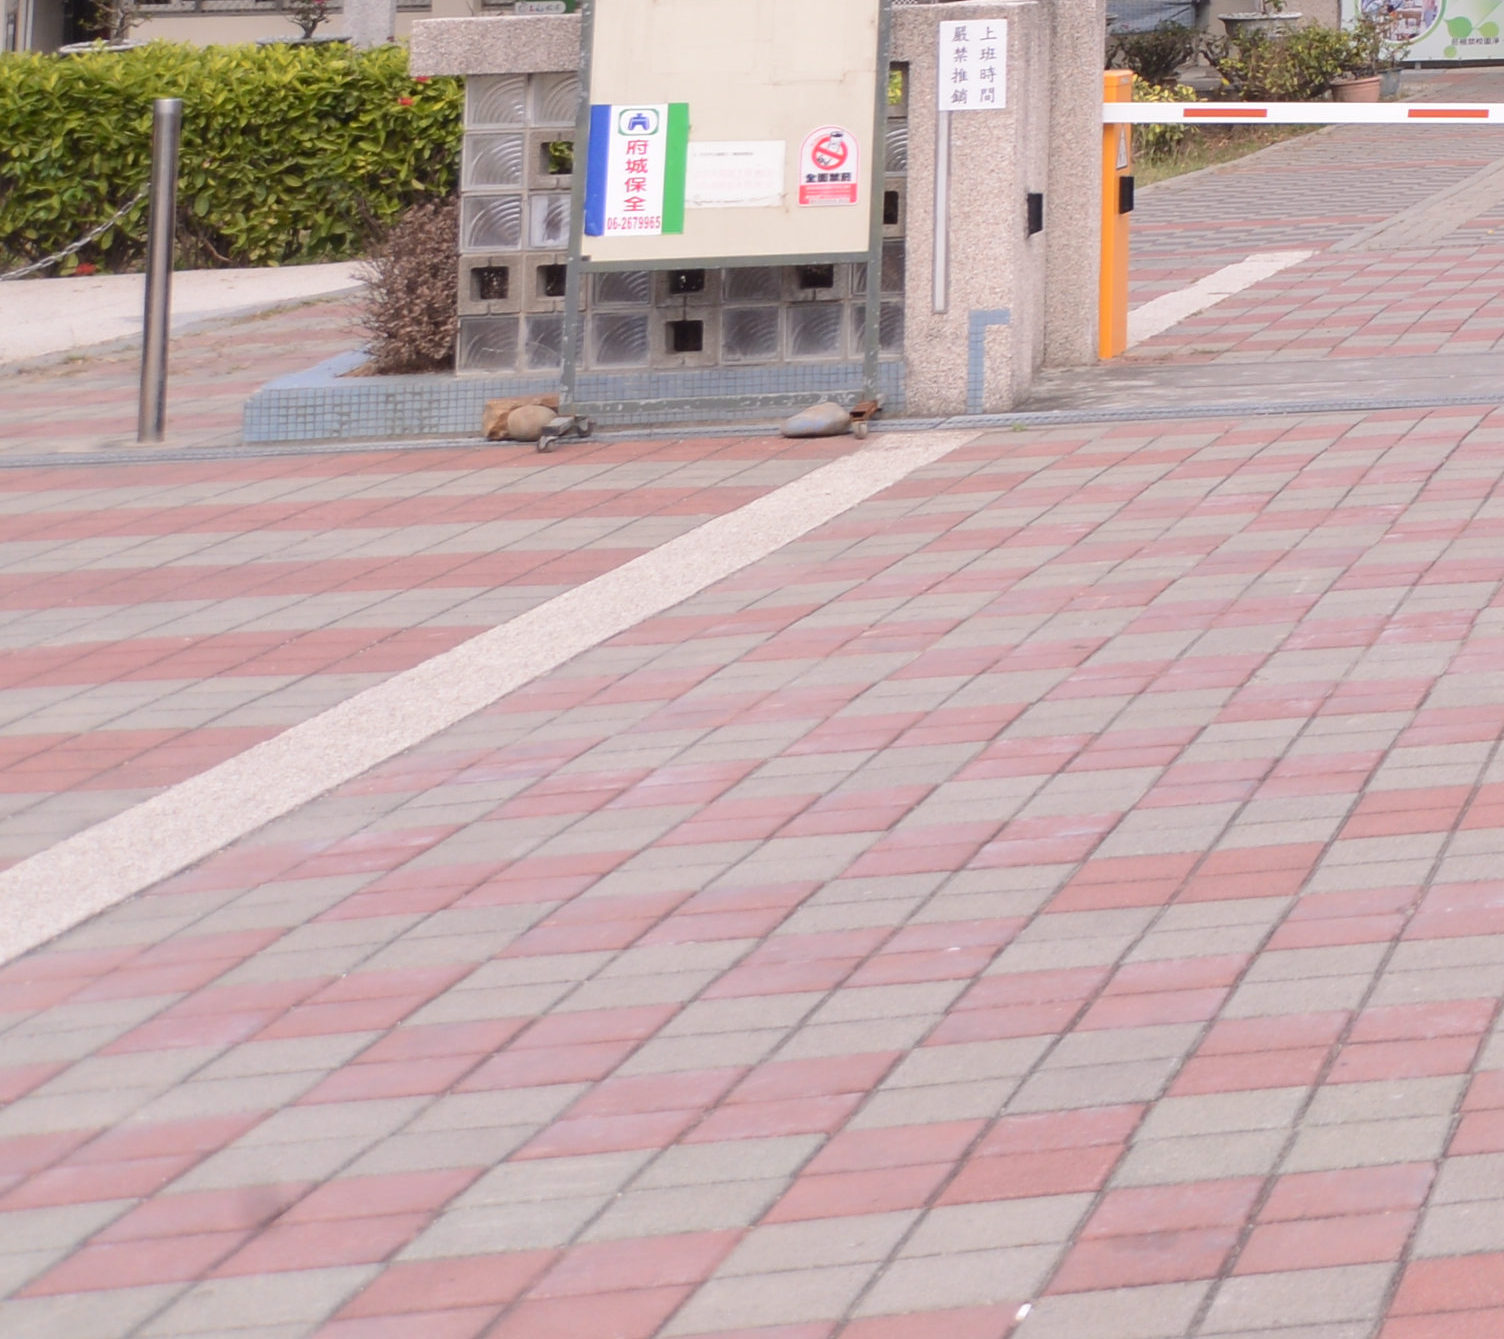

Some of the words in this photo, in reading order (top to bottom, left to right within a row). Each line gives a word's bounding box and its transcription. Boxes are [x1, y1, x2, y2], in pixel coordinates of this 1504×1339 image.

[951, 25, 970, 104] 嚴禁推銷
[979, 26, 997, 103] 上班時間
[623, 139, 649, 212] 府城保全
[607, 215, 661, 230] 06-2679965
